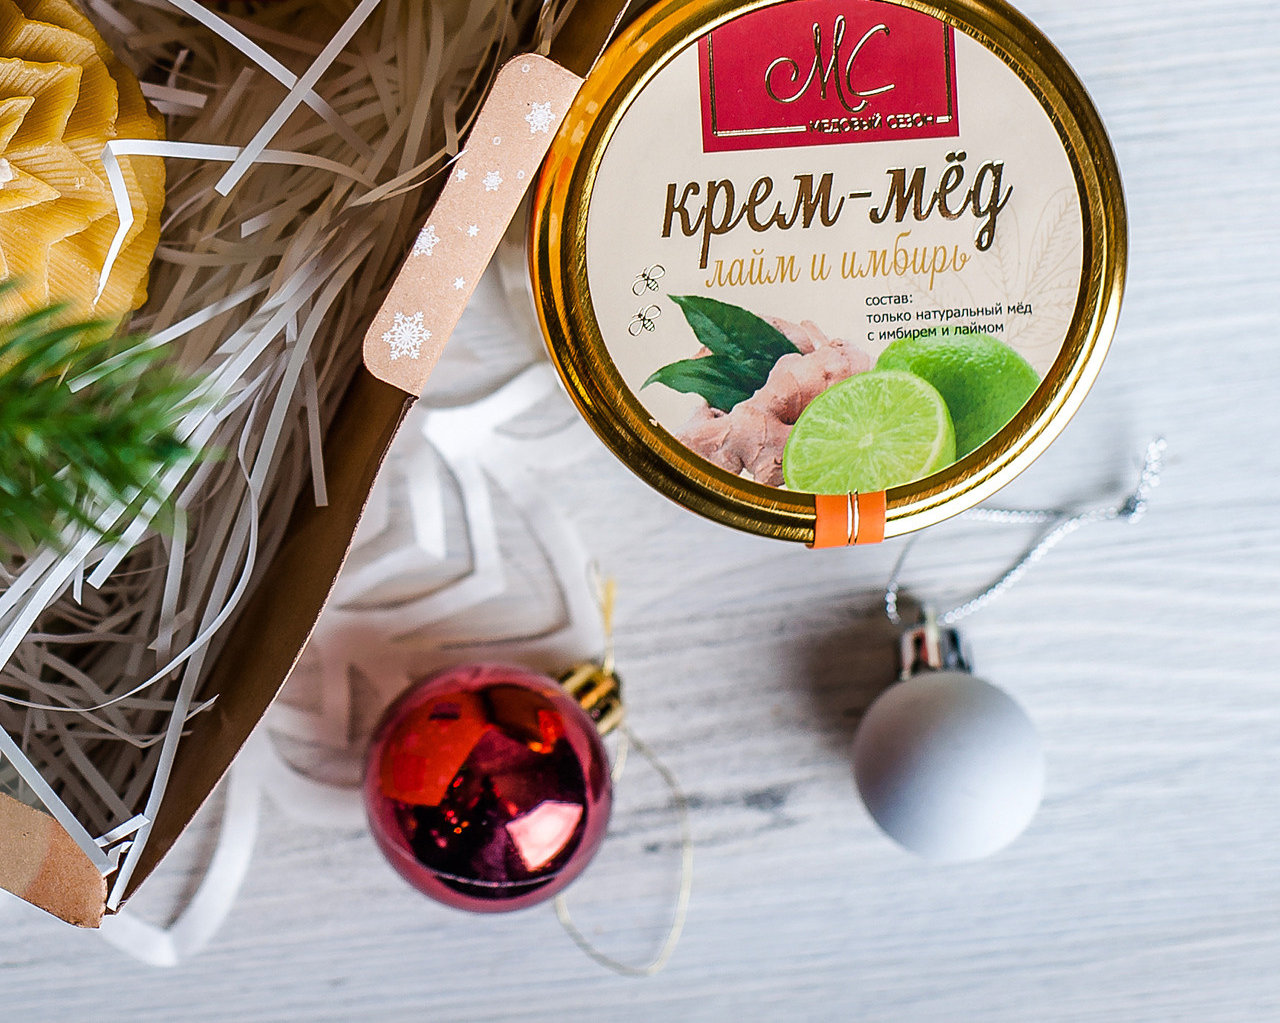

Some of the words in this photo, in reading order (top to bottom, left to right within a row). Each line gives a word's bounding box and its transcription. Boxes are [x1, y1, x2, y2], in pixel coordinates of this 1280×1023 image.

[809, 112, 883, 134] МЕДОВЫЙ
[886, 112, 934, 129] СЕЗОН
[661, 148, 1014, 270] крем-мёд
[705, 247, 803, 289] лайм
[811, 253, 831, 282] и
[839, 230, 972, 291] имбирь
[865, 293, 913, 307] состав:
[866, 310, 912, 324] только
[916, 302, 1003, 321] натуральный
[1007, 302, 1033, 315] мёд
[867, 331, 875, 342] с
[879, 326, 937, 342] имбирем
[941, 326, 950, 337] и
[954, 321, 1005, 336] лаймом
